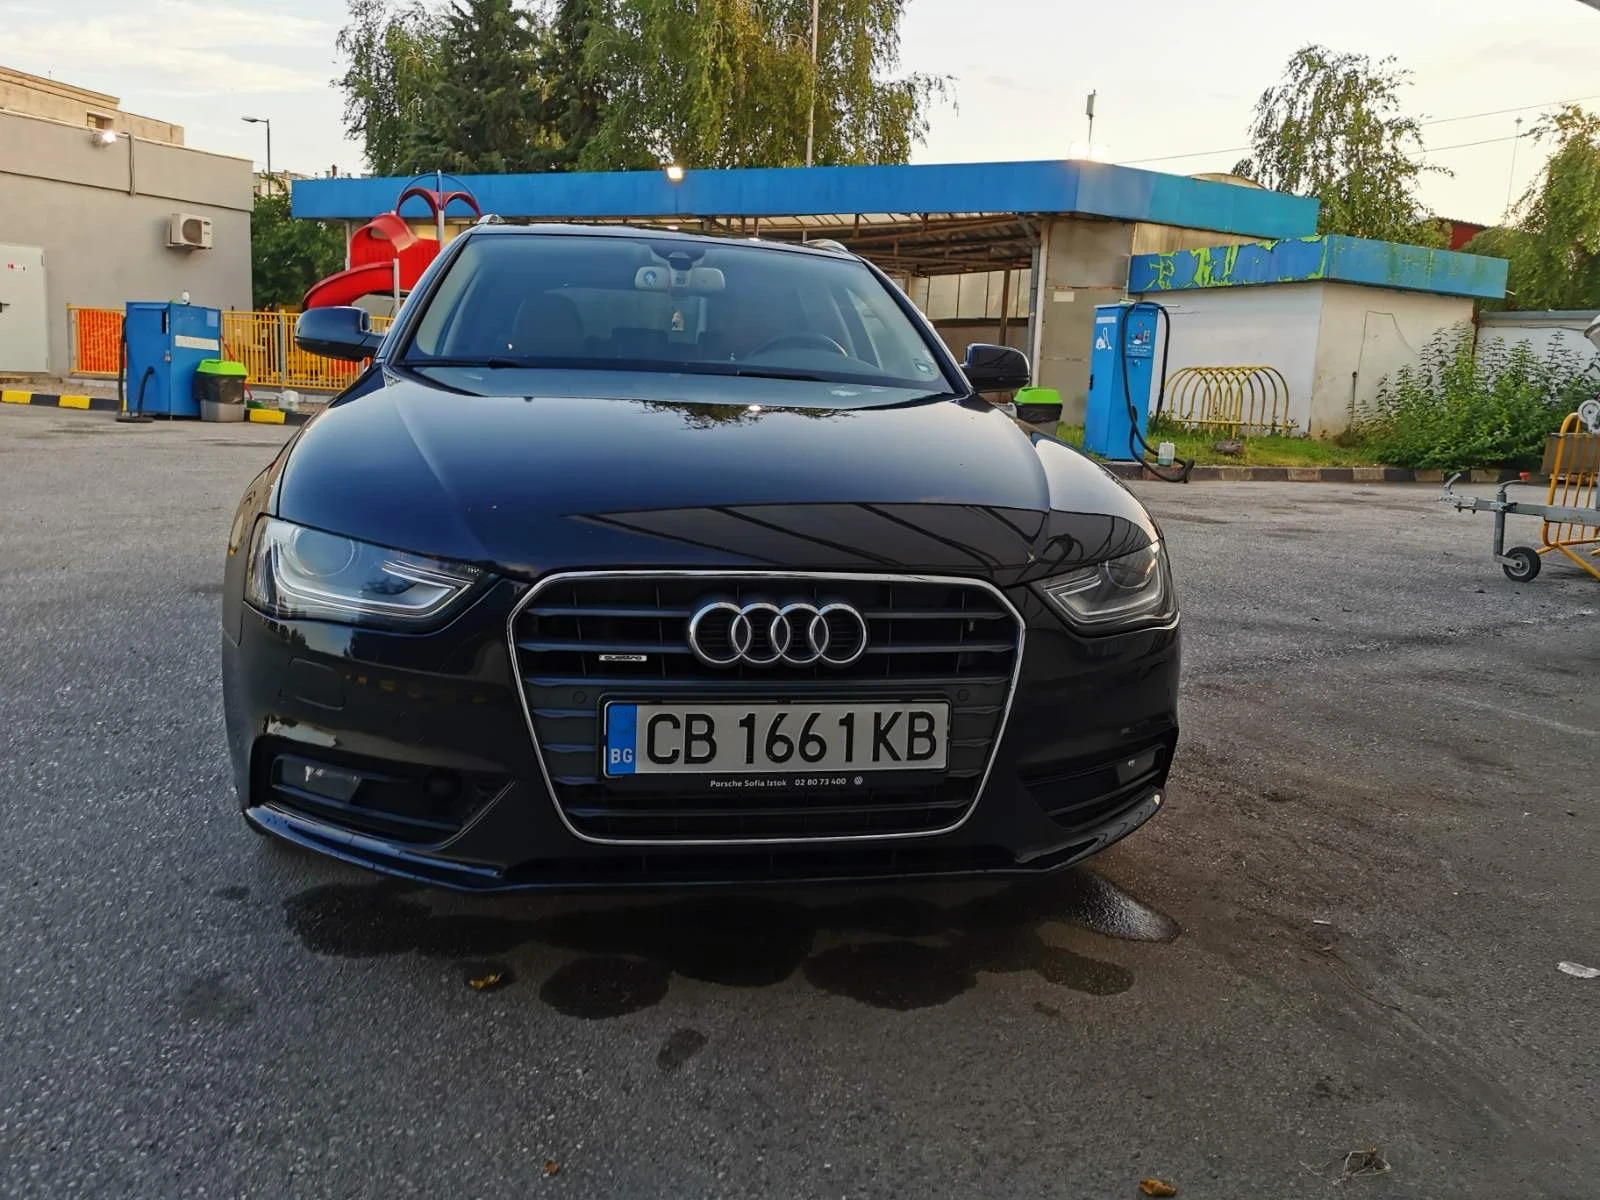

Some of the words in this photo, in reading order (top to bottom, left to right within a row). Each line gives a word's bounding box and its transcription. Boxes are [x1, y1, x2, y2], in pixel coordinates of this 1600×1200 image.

[647, 713, 717, 765] CB
[738, 712, 855, 764] 1661
[871, 711, 937, 762] KB
[610, 748, 633, 764] BG
[710, 780, 743, 788] Porsche
[744, 779, 765, 787] Sofia
[831, 777, 847, 785] 400
